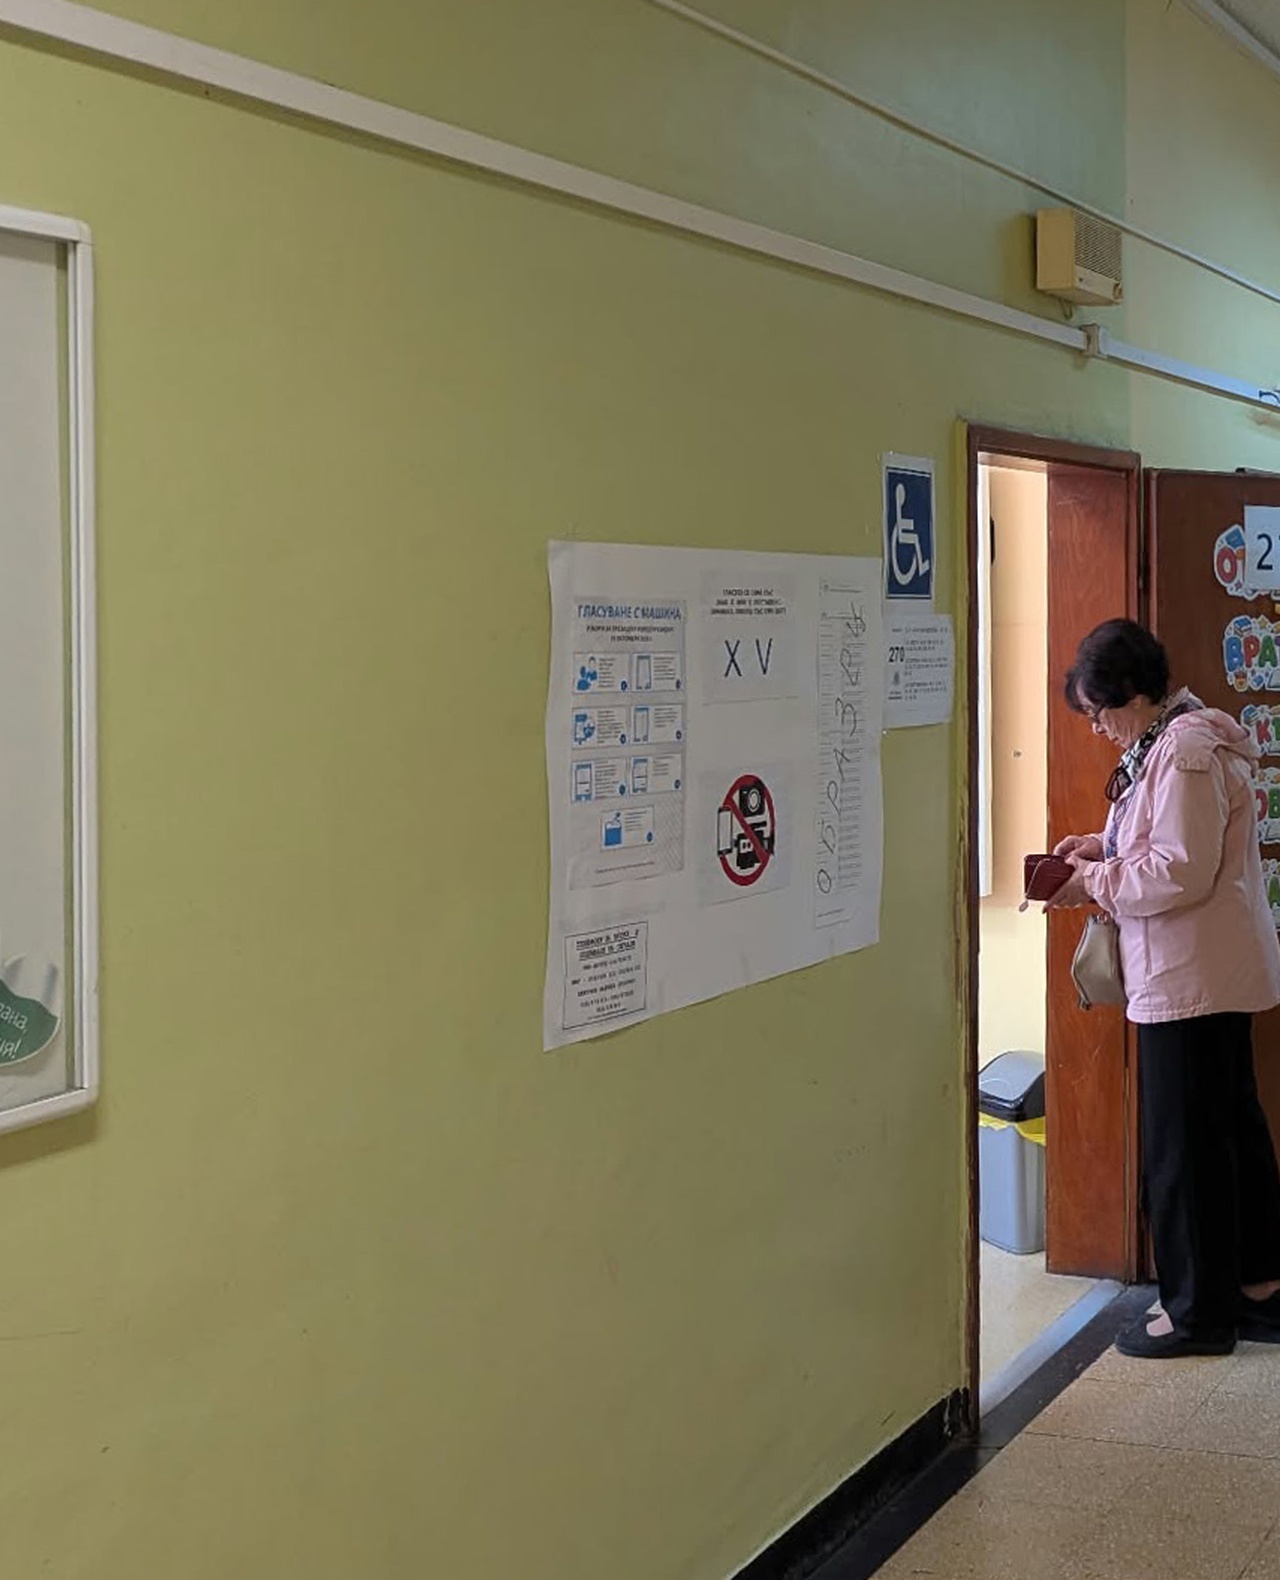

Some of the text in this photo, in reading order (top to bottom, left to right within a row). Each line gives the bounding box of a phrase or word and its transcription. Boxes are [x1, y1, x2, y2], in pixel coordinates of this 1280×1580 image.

[578, 605, 681, 620] ГЛАСУВАНЕ С МАШИНА
[889, 646, 905, 662] 270
